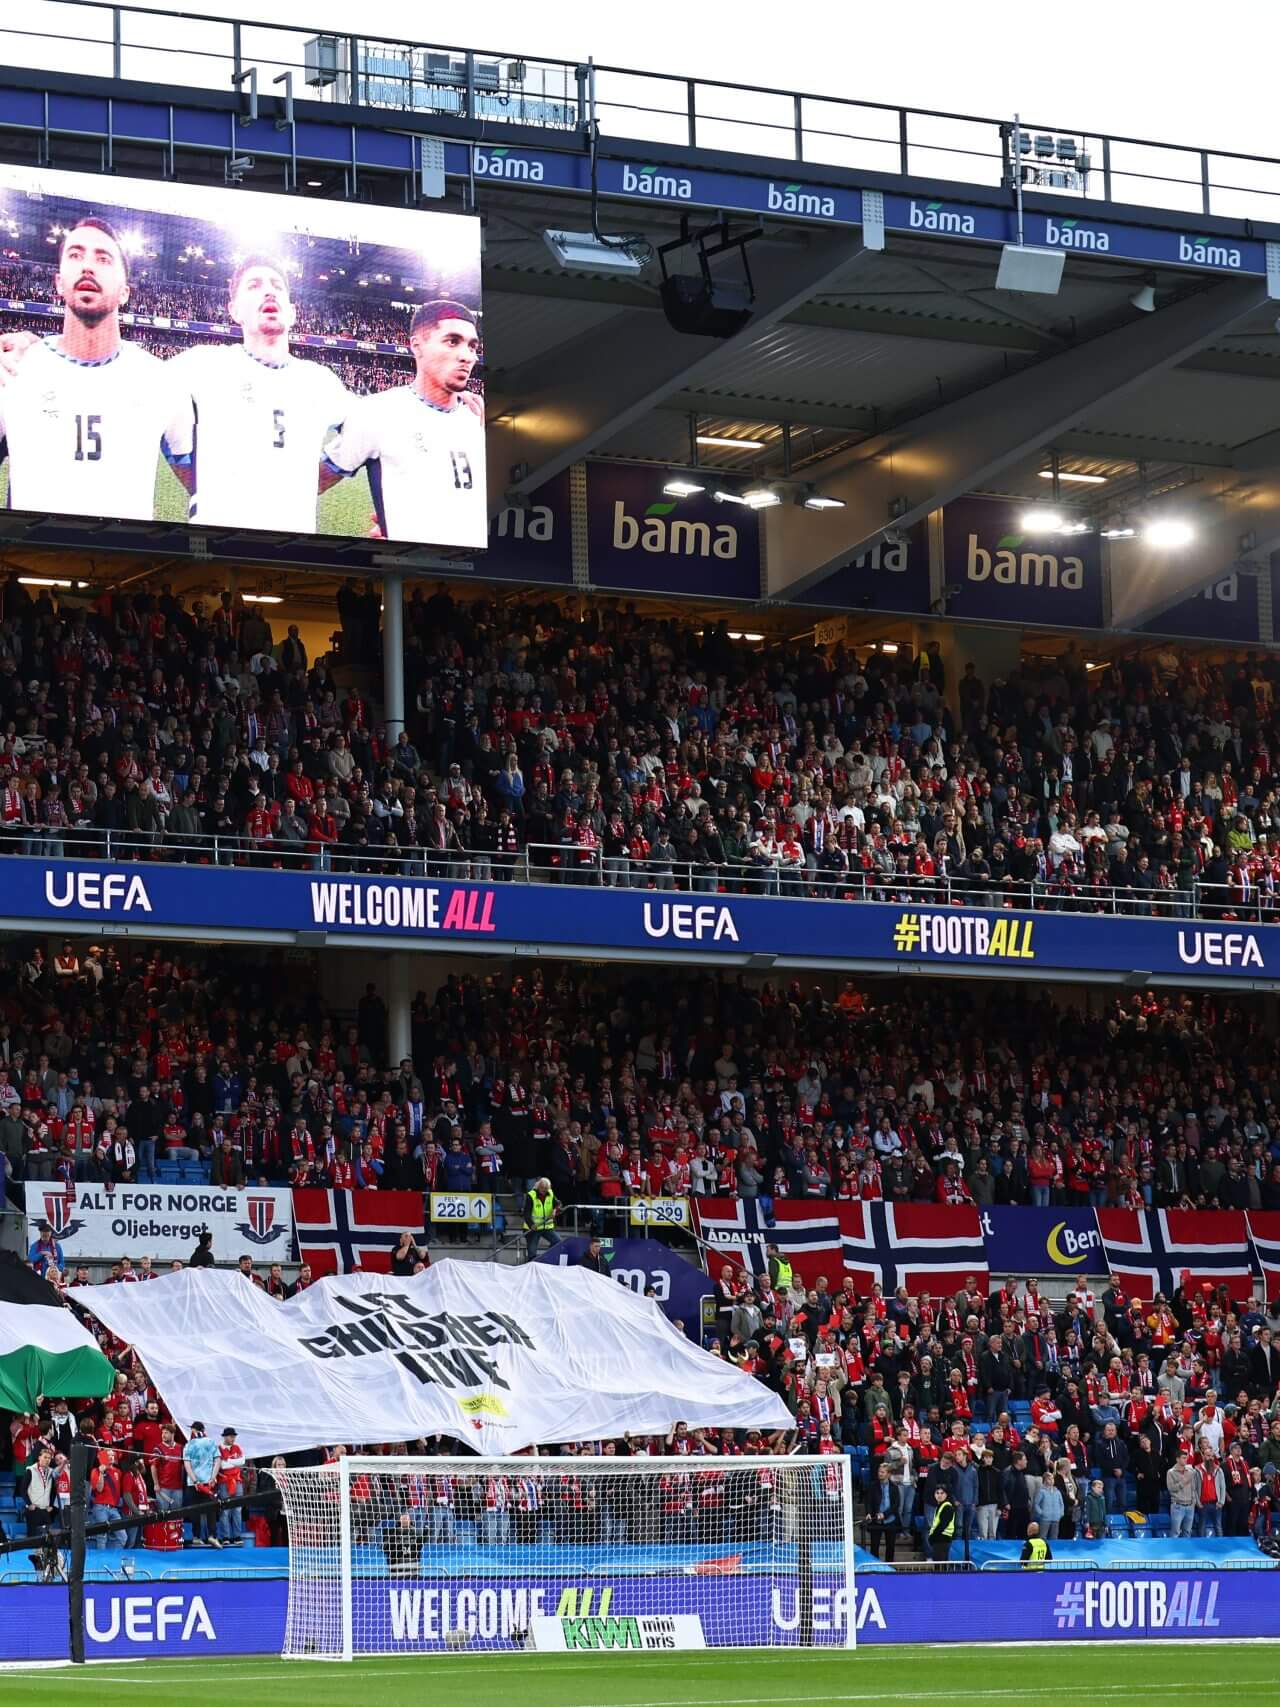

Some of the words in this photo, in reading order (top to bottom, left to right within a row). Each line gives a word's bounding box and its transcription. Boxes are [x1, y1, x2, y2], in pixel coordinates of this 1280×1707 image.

[473, 147, 544, 181] bama
[623, 165, 692, 198] bama
[768, 183, 835, 217] bama
[909, 201, 975, 234] bama
[1046, 219, 1109, 251] bama
[1179, 235, 1241, 268] bama
[74, 414, 102, 461] 15
[272, 409, 286, 449] 5
[449, 450, 473, 489] 13
[613, 500, 738, 559] bama
[967, 533, 1084, 590] bama
[46, 871, 153, 912] UEFA
[311, 882, 440, 928] WELCOME
[442, 889, 496, 932] ALL
[642, 903, 740, 942] UEFA
[893, 913, 1035, 959] #FOOTBALL
[1177, 930, 1265, 967] UEFA
[80, 1192, 116, 1211] ALT
[122, 1193, 162, 1211] FOR
[167, 1194, 237, 1213] NORGE
[656, 1206, 683, 1222] 229
[111, 1218, 209, 1240] Oljeberget
[85, 1595, 217, 1643] UEFA
[389, 1588, 545, 1641] WELCOME
[772, 1587, 887, 1630] UEFA
[1053, 1580, 1220, 1629] #FOOTBALL
[561, 1617, 643, 1649] KIWI
[642, 1617, 675, 1632] mini
